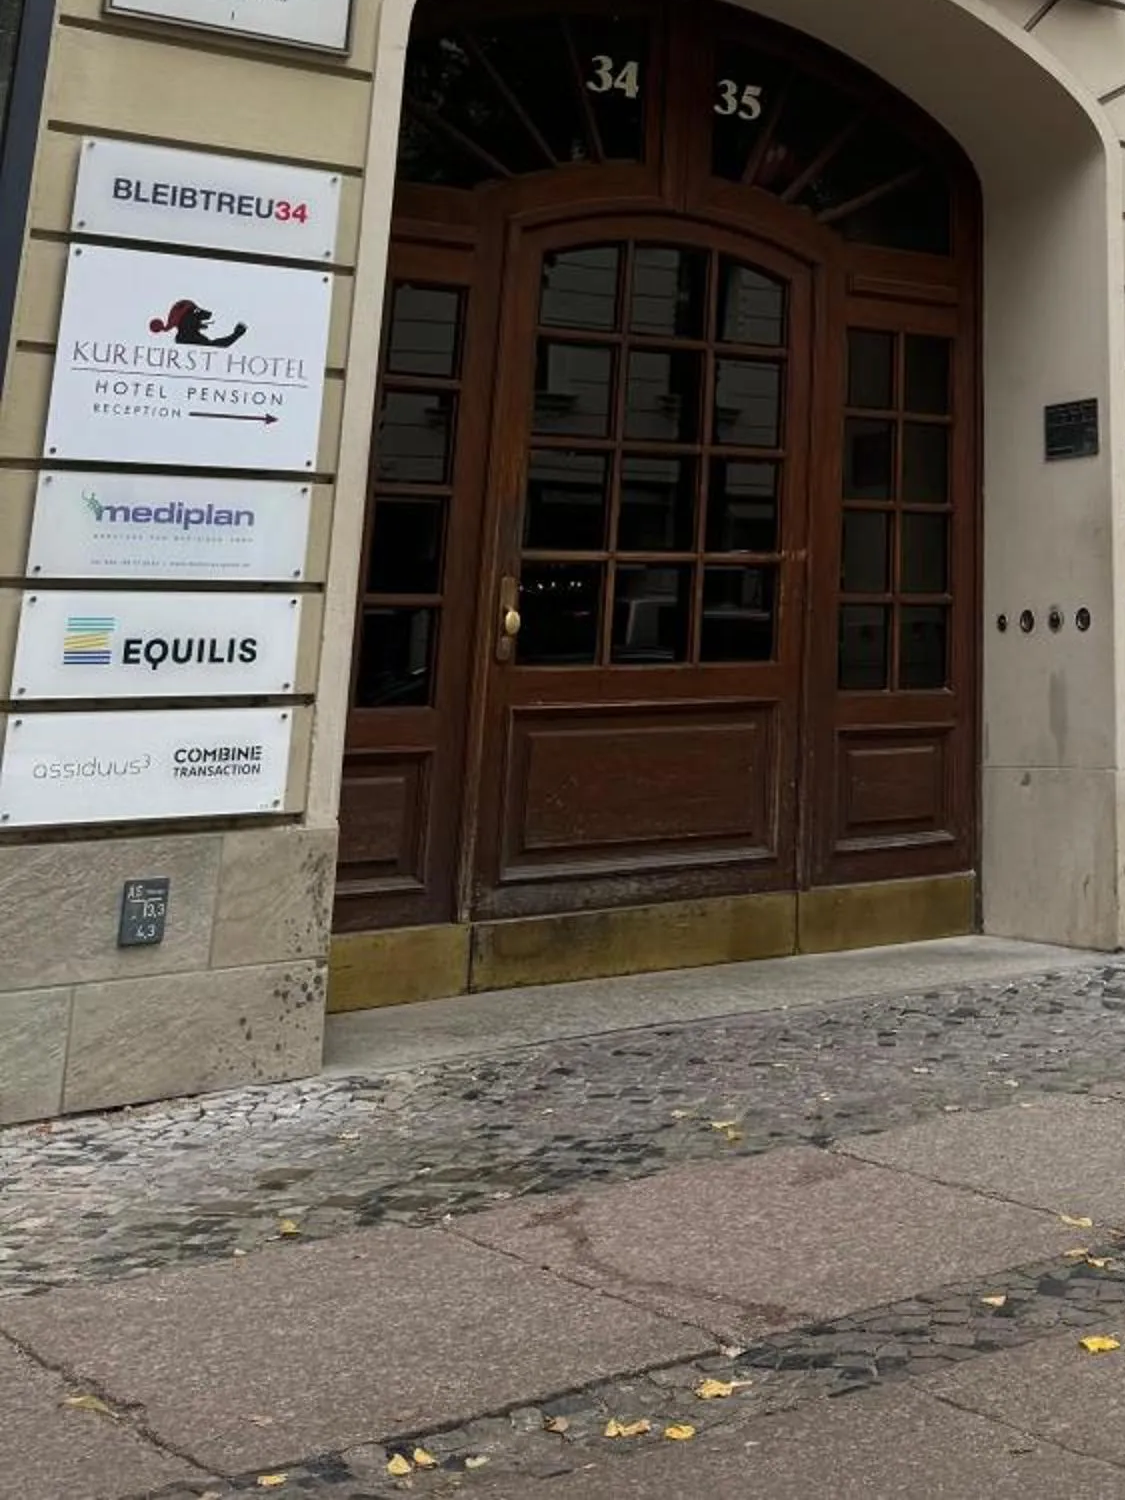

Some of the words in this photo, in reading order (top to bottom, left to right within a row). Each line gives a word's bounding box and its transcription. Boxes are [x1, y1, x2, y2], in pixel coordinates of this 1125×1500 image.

[586, 55, 640, 99] 34
[713, 79, 762, 120] 35
[112, 177, 309, 223] BLEIBTREU34
[73, 341, 218, 372] KURFÜRST
[227, 354, 309, 381] HOTEL
[95, 379, 168, 400] HOTEL
[187, 386, 284, 406] PENSION
[93, 402, 182, 419] RECEPTION
[95, 501, 255, 531] mediplan
[122, 638, 258, 670] EQUILIS
[173, 745, 263, 764] COMBINE
[173, 763, 261, 778] TRANSACTION
